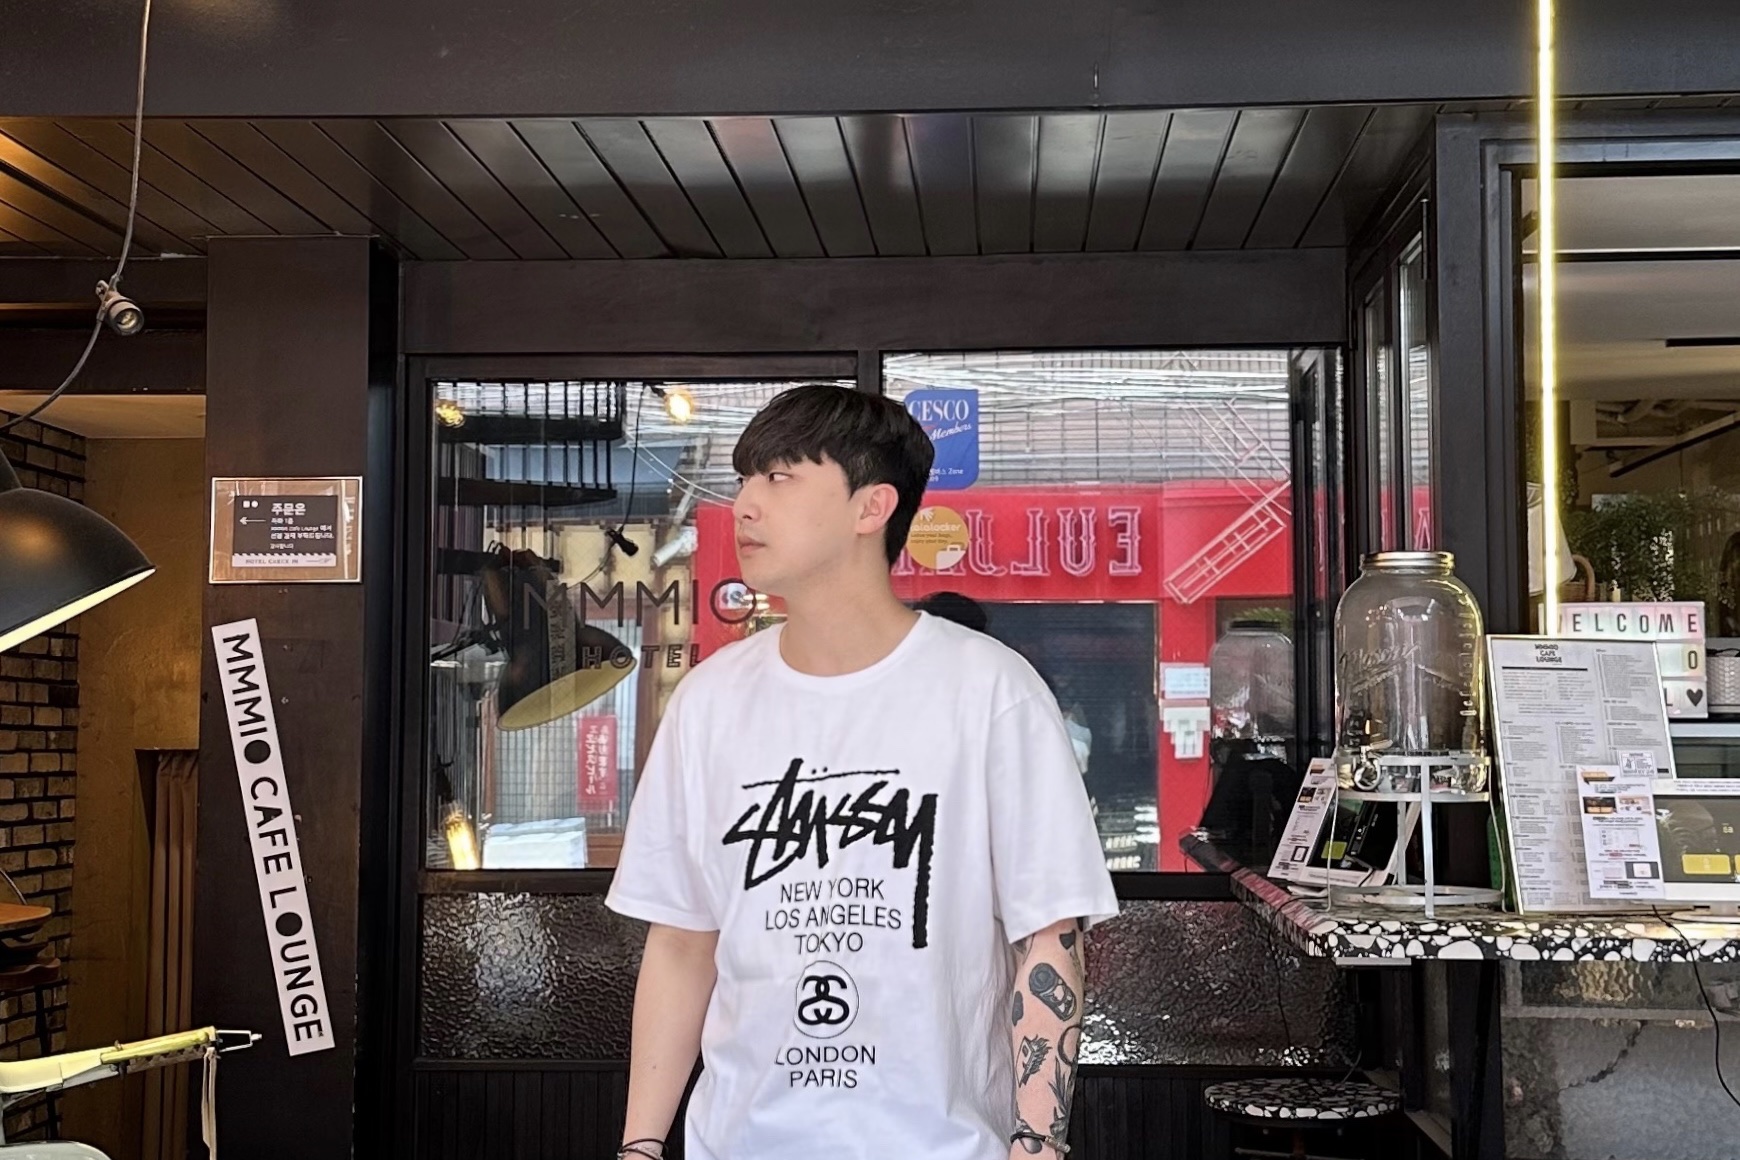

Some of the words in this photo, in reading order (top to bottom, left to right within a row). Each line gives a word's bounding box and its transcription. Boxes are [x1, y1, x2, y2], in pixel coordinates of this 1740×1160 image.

[908, 399, 970, 421] CESCO
[929, 421, 972, 440] Members
[271, 502, 307, 516] 주문은
[1558, 613, 1698, 634] ELCOME
[582, 643, 702, 669] HOTEL
[222, 633, 271, 764] MMMIO
[250, 776, 293, 875] CAFE
[780, 880, 823, 904] NEW
[829, 877, 885, 900] YORK
[765, 909, 800, 931] LOS
[805, 904, 902, 930] ANGELES
[794, 932, 864, 955] TOKYO
[269, 886, 324, 1042] LOUNGE
[774, 1045, 876, 1066] LONDON
[789, 1068, 858, 1089] PARIS
